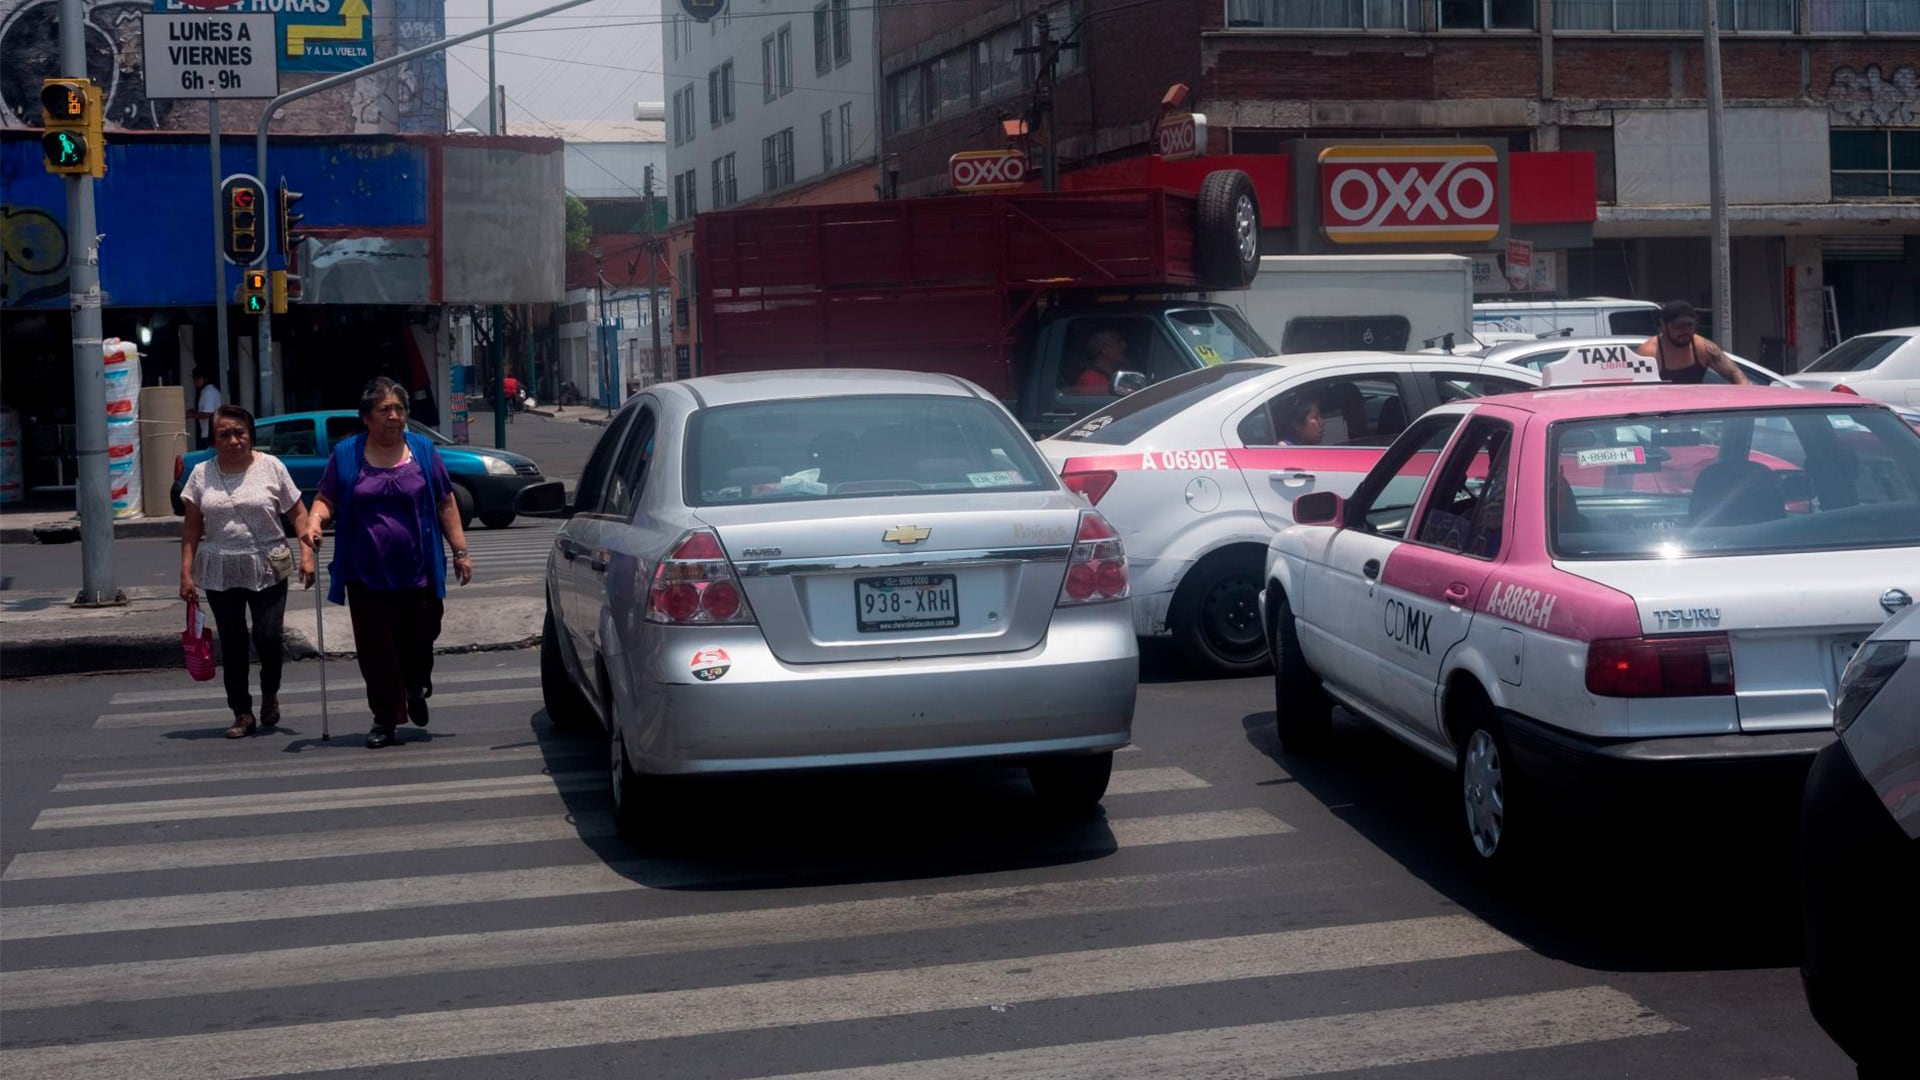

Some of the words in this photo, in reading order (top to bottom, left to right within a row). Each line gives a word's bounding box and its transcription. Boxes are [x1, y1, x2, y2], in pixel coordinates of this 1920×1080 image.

[169, 22, 233, 41] LUNES
[237, 22, 251, 41] A
[168, 46, 252, 65] VIERNES
[306, 46, 312, 55] Y
[314, 46, 320, 55] A
[322, 46, 333, 55] LA
[335, 47, 368, 56] VUELTA
[181, 70, 204, 89] 6h
[219, 70, 241, 88] 9h
[1160, 120, 1194, 154] OXXO
[954, 157, 1024, 186] OXXO
[1330, 161, 1494, 226] OXXO
[1577, 346, 1628, 365] TAXI
[1600, 361, 1628, 370] LIBRE
[1141, 453, 1159, 470] A
[1162, 451, 1229, 470] 0690E
[865, 589, 951, 614] 938-XRH
[1486, 581, 1557, 629] A-8868-H
[1653, 607, 1721, 624] TSURU
[1384, 598, 1433, 655] CDMX
